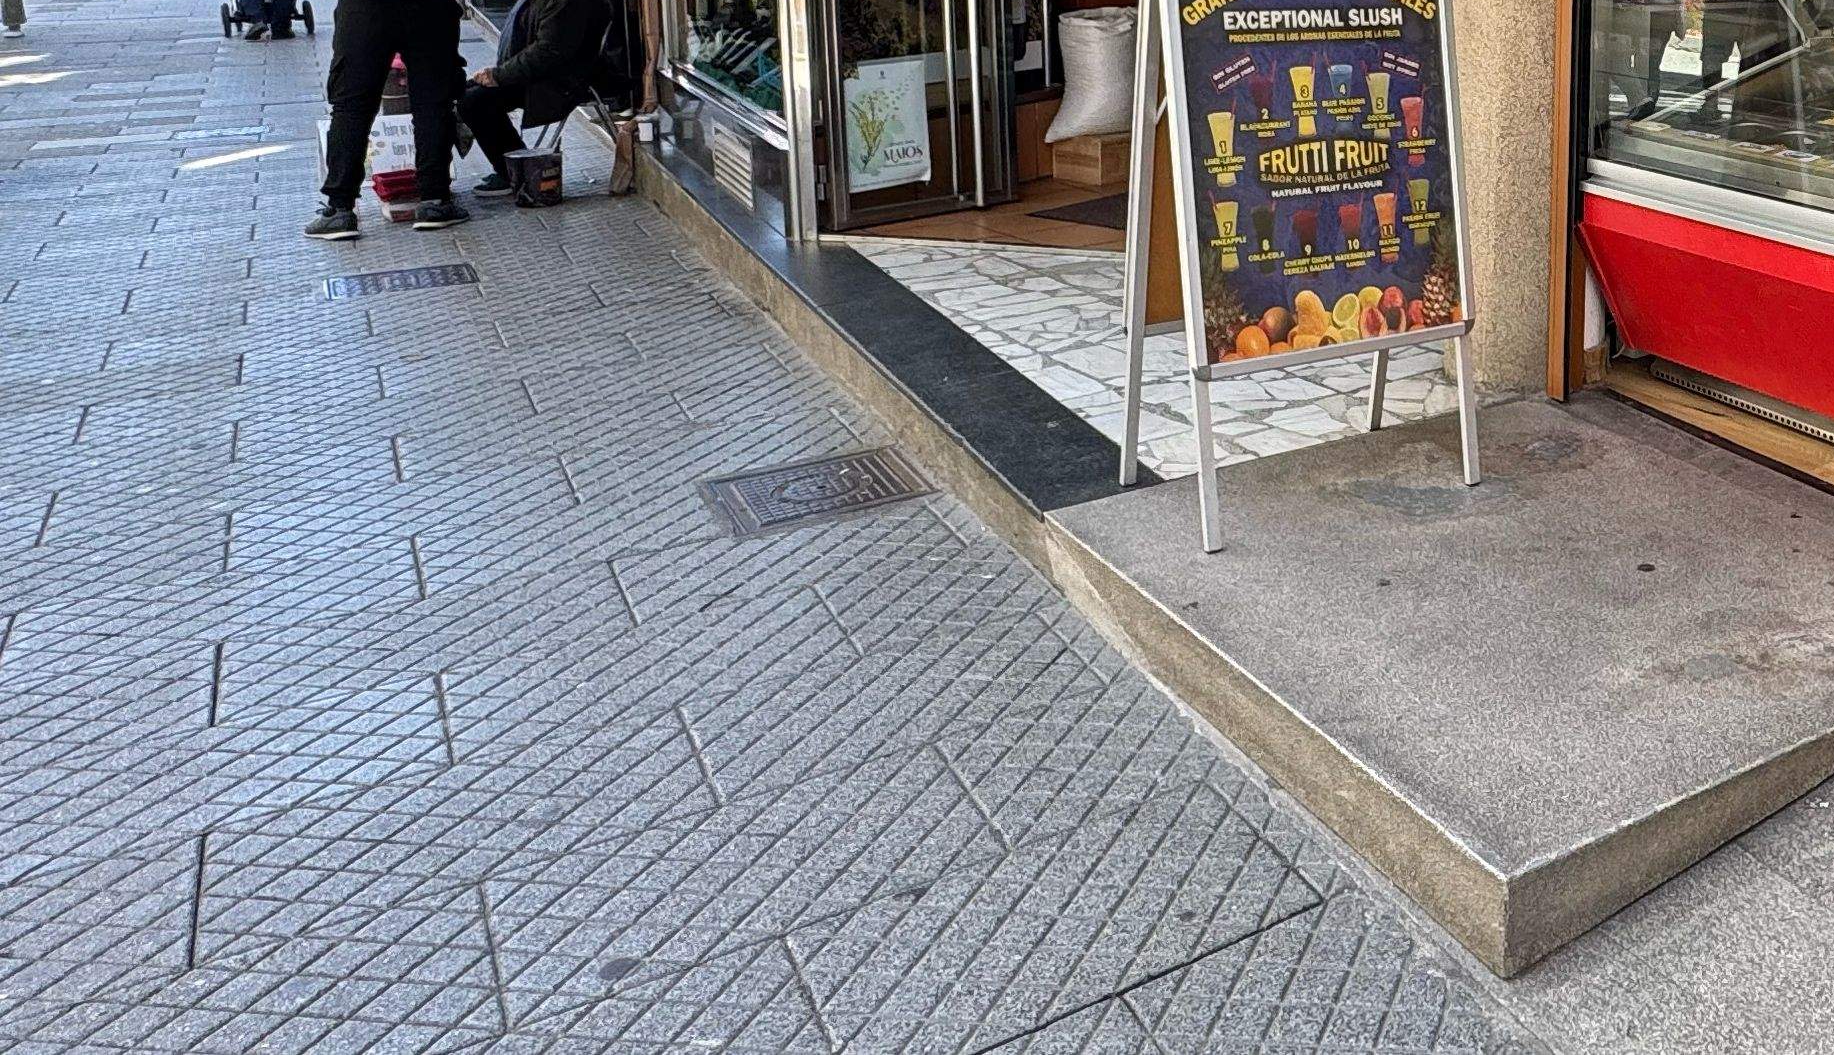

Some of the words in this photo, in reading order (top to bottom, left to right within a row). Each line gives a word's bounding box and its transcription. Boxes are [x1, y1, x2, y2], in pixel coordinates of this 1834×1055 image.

[1222, 9, 1345, 31] EXCEPTIONAL
[1348, 7, 1404, 27] SLUSH
[1300, 85, 1309, 98] 3
[1339, 84, 1346, 95] 4
[1376, 98, 1384, 110] 5
[1261, 108, 1269, 120] 2
[1411, 127, 1418, 137] 6
[1219, 141, 1227, 154] 1
[1259, 140, 1328, 175] FRUTTI
[1334, 140, 1389, 171] FRUIT
[1260, 173, 1292, 183] SABOR
[1295, 175, 1335, 184] NATURAL
[1337, 173, 1349, 181] DE
[1351, 169, 1362, 179] LA
[1364, 163, 1391, 176] FRUTA
[1271, 187, 1313, 198] NATURAL
[1315, 184, 1340, 194] FRUIT
[1343, 180, 1383, 190] FLAVOUR
[1414, 200, 1426, 211] 12
[1223, 222, 1233, 235] 7
[1382, 225, 1393, 236] 11
[1211, 236, 1247, 246] PINEAPPLE
[1262, 239, 1270, 251] 8
[1348, 239, 1360, 250] 10
[1304, 244, 1312, 255] 9
